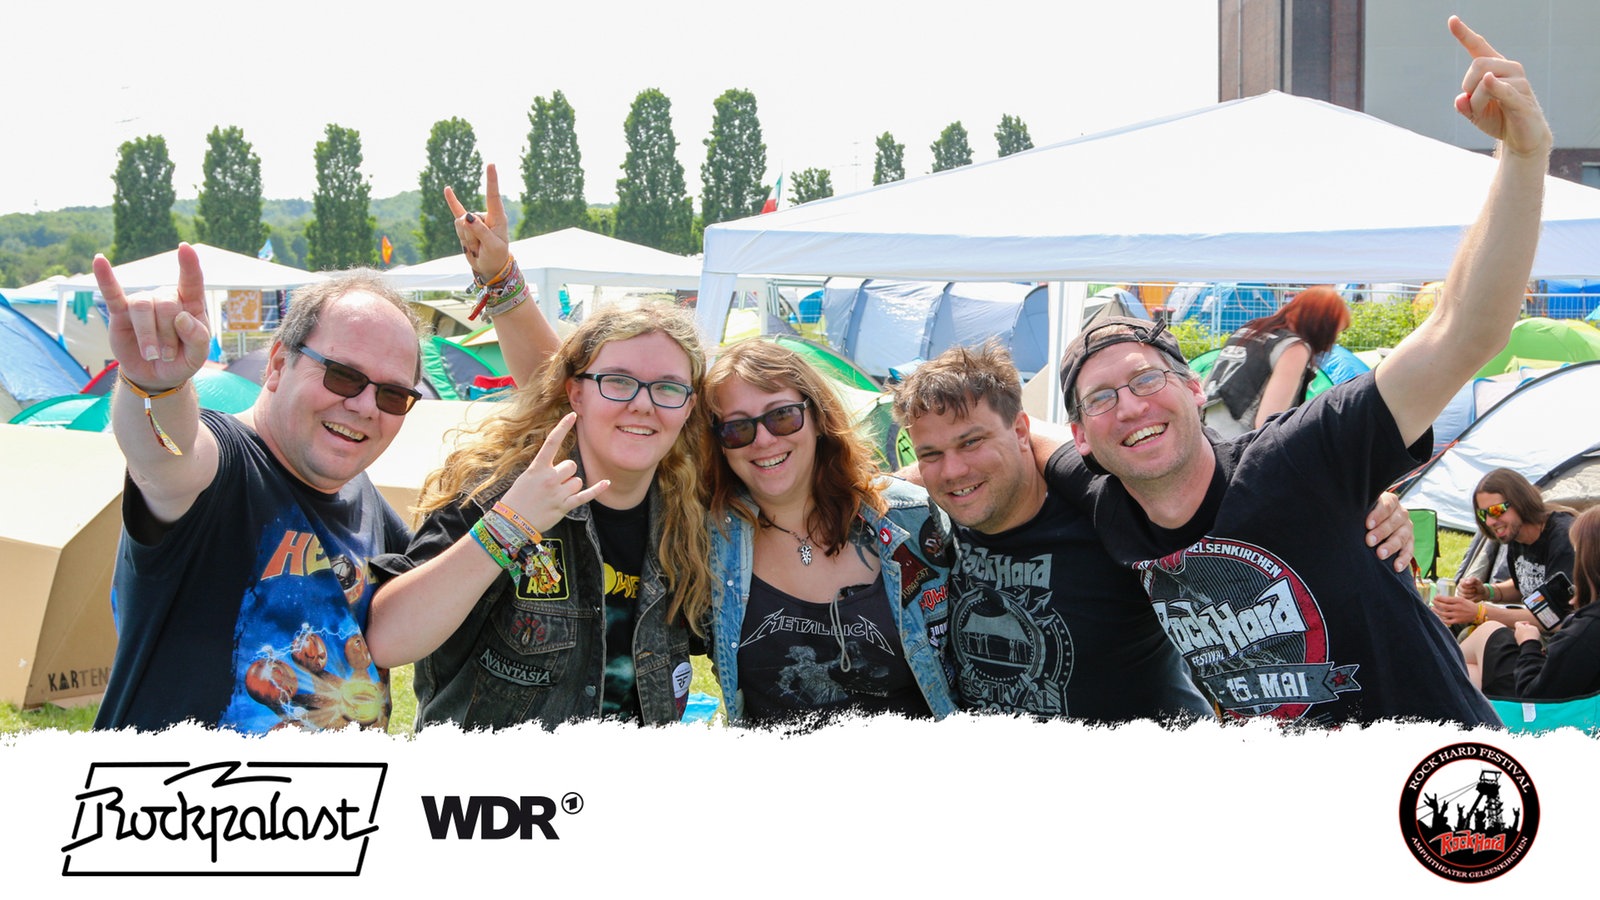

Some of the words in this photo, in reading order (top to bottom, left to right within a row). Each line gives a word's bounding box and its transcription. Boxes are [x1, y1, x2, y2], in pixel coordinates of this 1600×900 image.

[479, 648, 553, 684] AVANTASIA
[1191, 650, 1226, 667] FESTIVAL
[1258, 672, 1310, 698] MAI
